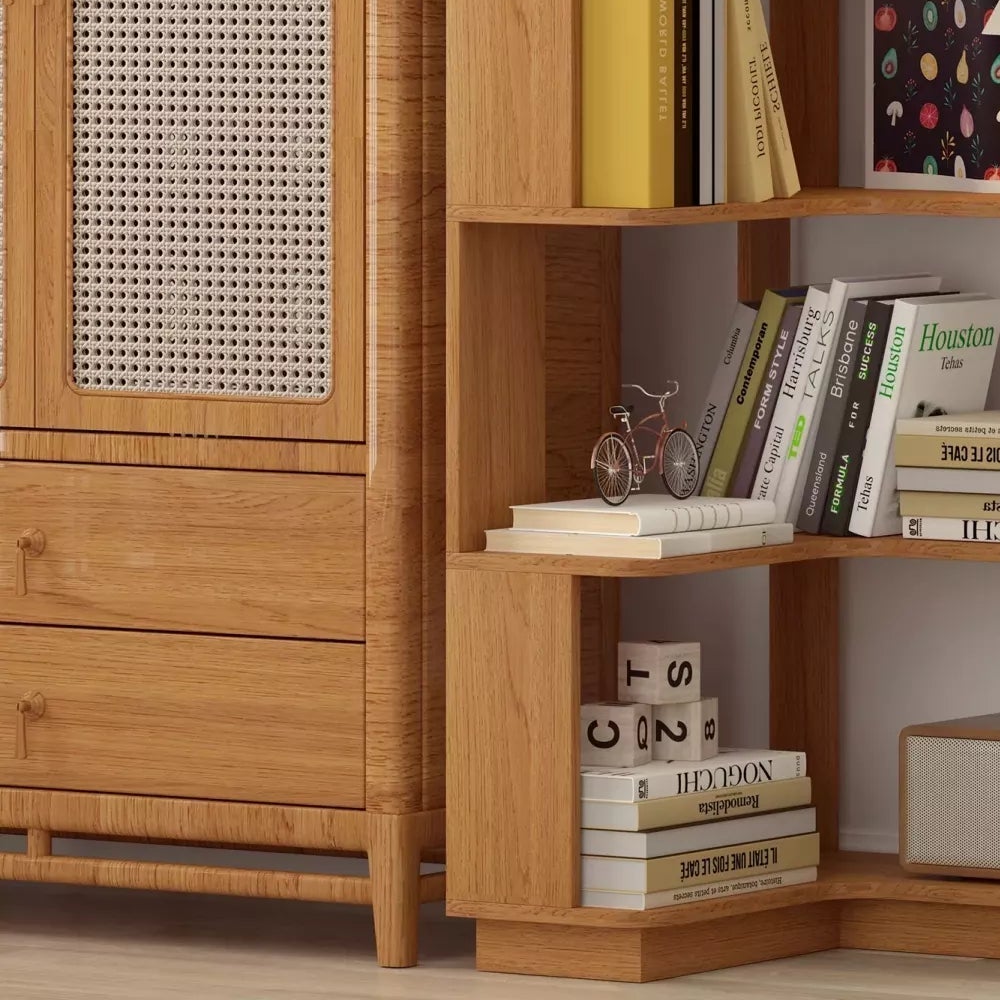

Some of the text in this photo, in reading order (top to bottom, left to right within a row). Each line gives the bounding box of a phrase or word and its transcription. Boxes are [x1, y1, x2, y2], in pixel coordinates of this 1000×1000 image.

[723, 327, 741, 365] Columbia
[782, 306, 821, 399] Harrisburg
[918, 322, 995, 352] Houston
[736, 321, 768, 405] Contemporan
[830, 319, 859, 399] Brisbane
[878, 325, 906, 400] Houston
[941, 355, 964, 371] Tehas
[753, 329, 789, 430] FORM STYLE
[787, 309, 834, 460] TED TALKS
[830, 322, 877, 514] FORMULA FOR SUCCESS
[763, 426, 785, 474] Capital
[856, 475, 874, 513] Tehas
[626, 659, 650, 686] T
[667, 660, 693, 688] S
[587, 719, 620, 749] C
[637, 715, 648, 750] Q
[704, 717, 716, 740] 8
[677, 760, 773, 794] NOGUCHI
[699, 794, 759, 816] Remodelista
[680, 847, 778, 882] IL ÉTAIT UNE FOIS LE CAFÉ
